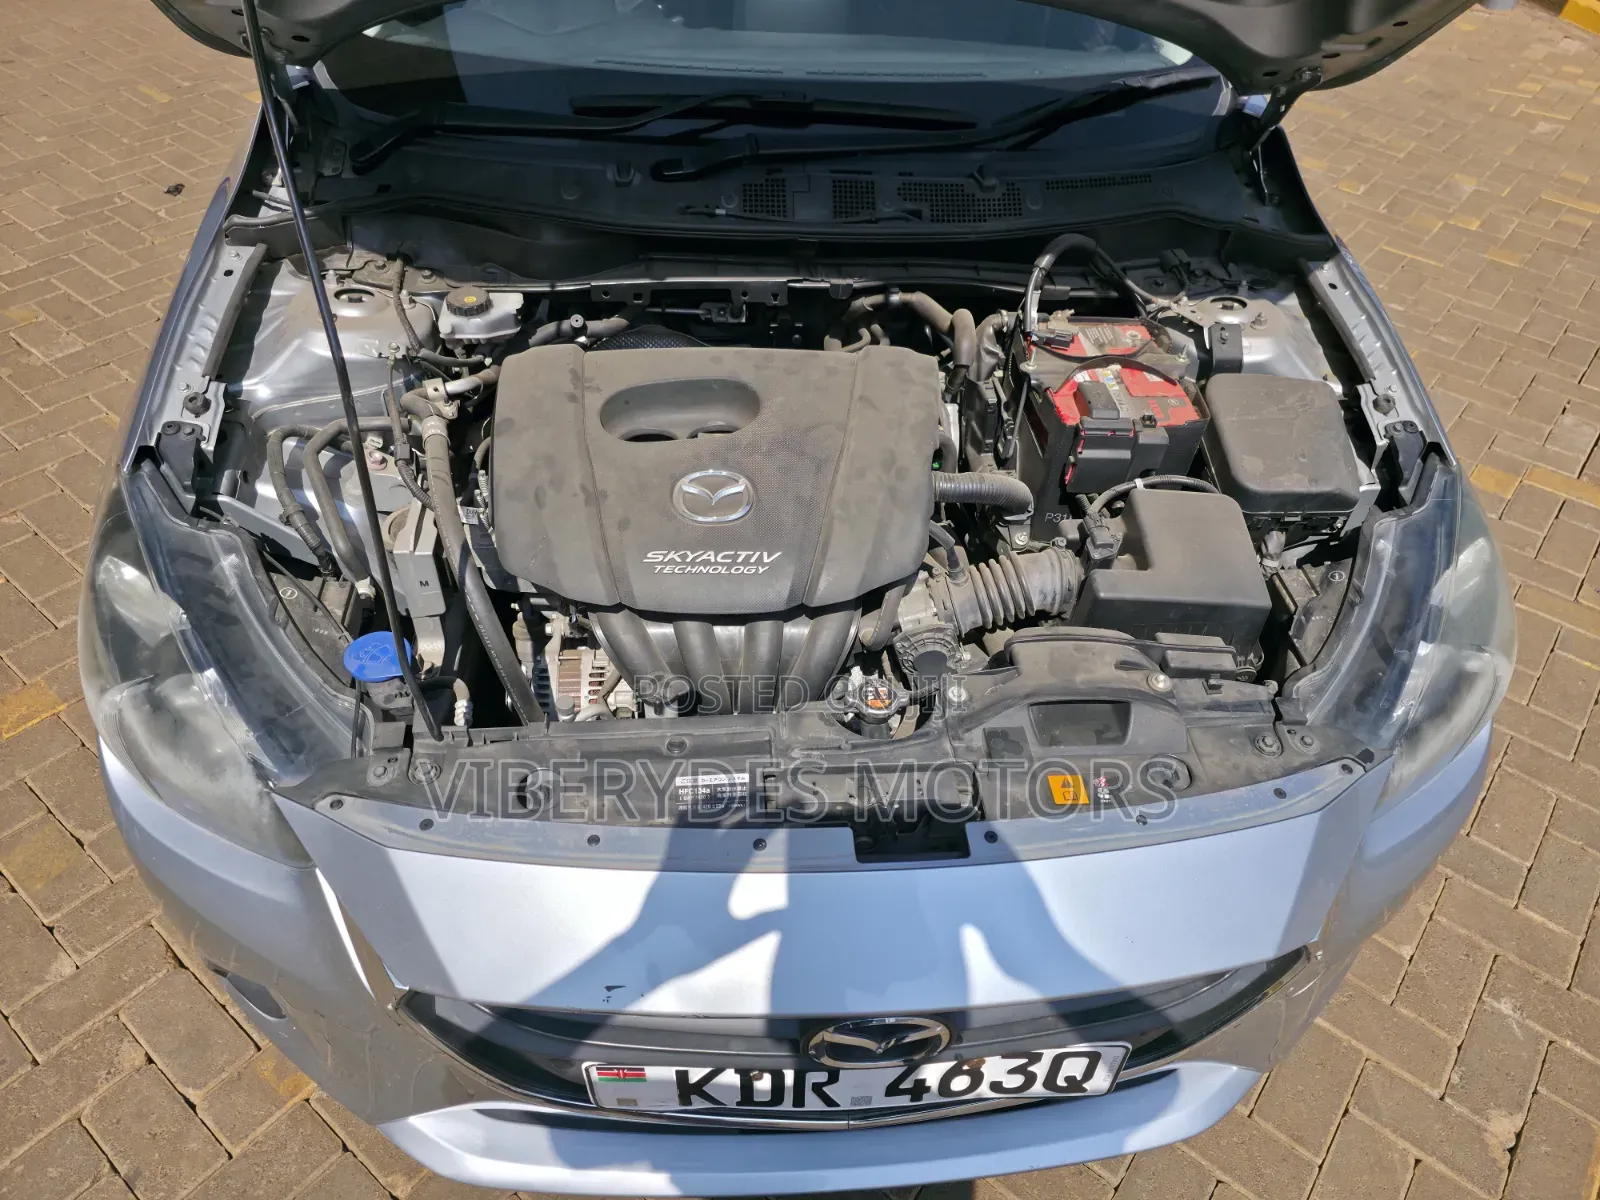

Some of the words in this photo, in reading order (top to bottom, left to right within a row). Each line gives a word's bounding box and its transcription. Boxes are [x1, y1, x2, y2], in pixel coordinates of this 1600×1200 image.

[642, 550, 783, 563] SKYACTIV
[653, 565, 770, 574] TECHNOLOGY
[675, 1067, 842, 1109] KDR
[884, 1050, 1103, 1103] 463Q
